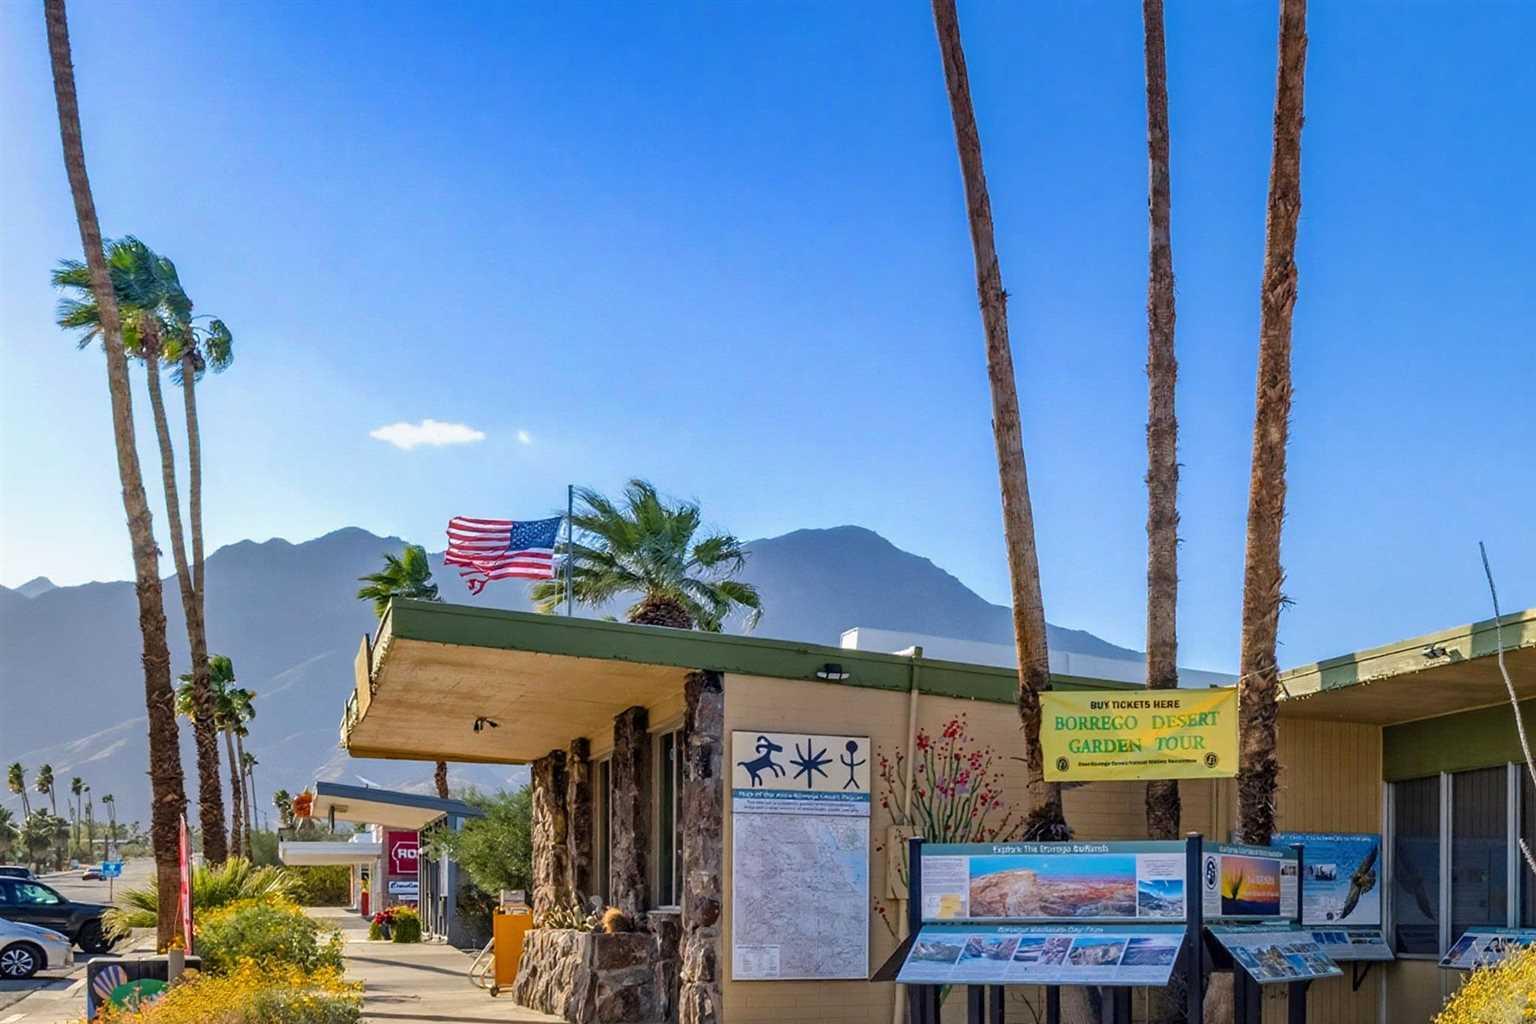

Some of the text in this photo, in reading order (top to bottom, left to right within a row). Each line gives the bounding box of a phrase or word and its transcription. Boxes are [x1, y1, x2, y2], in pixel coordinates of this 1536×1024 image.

[1090, 699, 1181, 710] BUY TICKETS HERE
[1055, 711, 1220, 731] BORREGO DESERT
[1068, 735, 1206, 753] GARDEN TOUR
